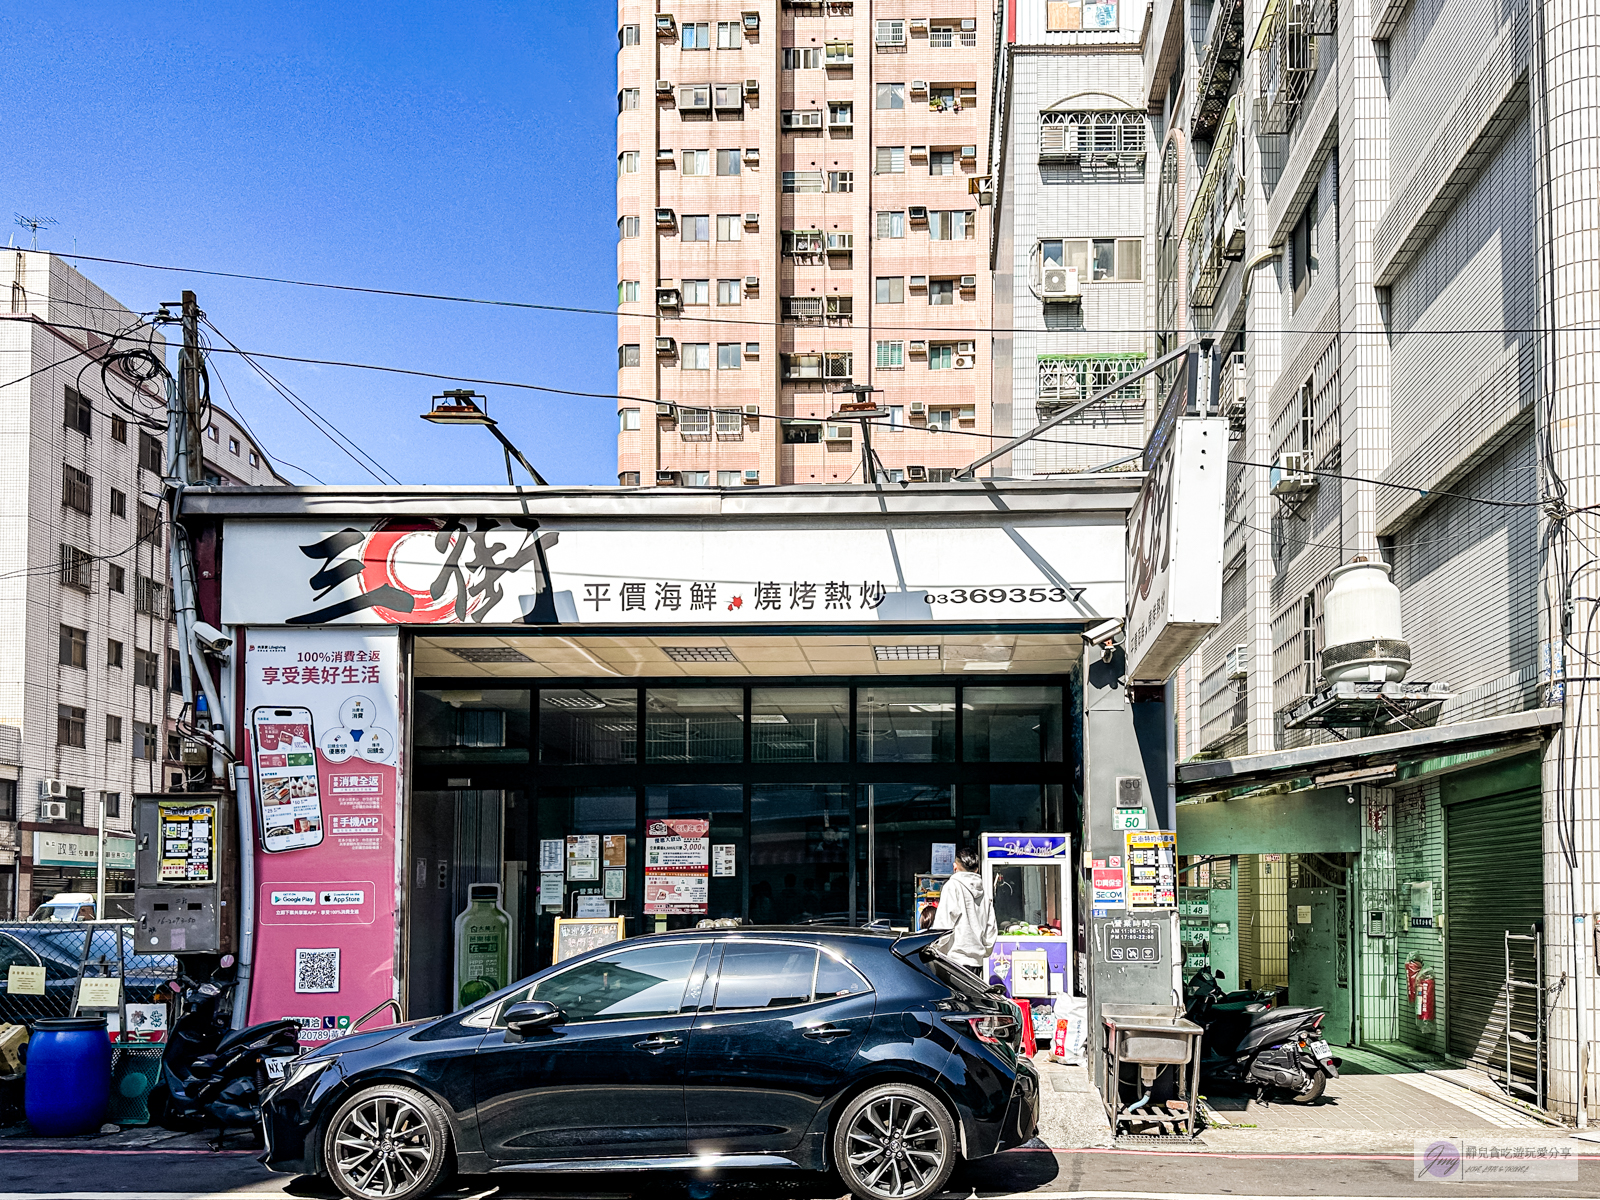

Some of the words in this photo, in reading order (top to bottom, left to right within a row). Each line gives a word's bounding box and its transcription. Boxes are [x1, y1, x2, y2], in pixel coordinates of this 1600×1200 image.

[583, 581, 719, 611] 平價海鮮
[754, 580, 886, 611] 燒烤熱炒
[924, 587, 1087, 605] 033693537
[297, 650, 381, 663] 100%消費全返
[262, 665, 380, 686] 享受美好生活
[339, 776, 379, 786] 消費全返
[1125, 779, 1140, 789] 50
[340, 816, 379, 827] 手機APP
[1125, 817, 1139, 828] 50
[683, 843, 702, 851] 3,000
[1095, 879, 1121, 887] 中興保全
[282, 896, 301, 904] Google
[1114, 919, 1150, 927] 營業時間
[1193, 959, 1204, 967] 48
